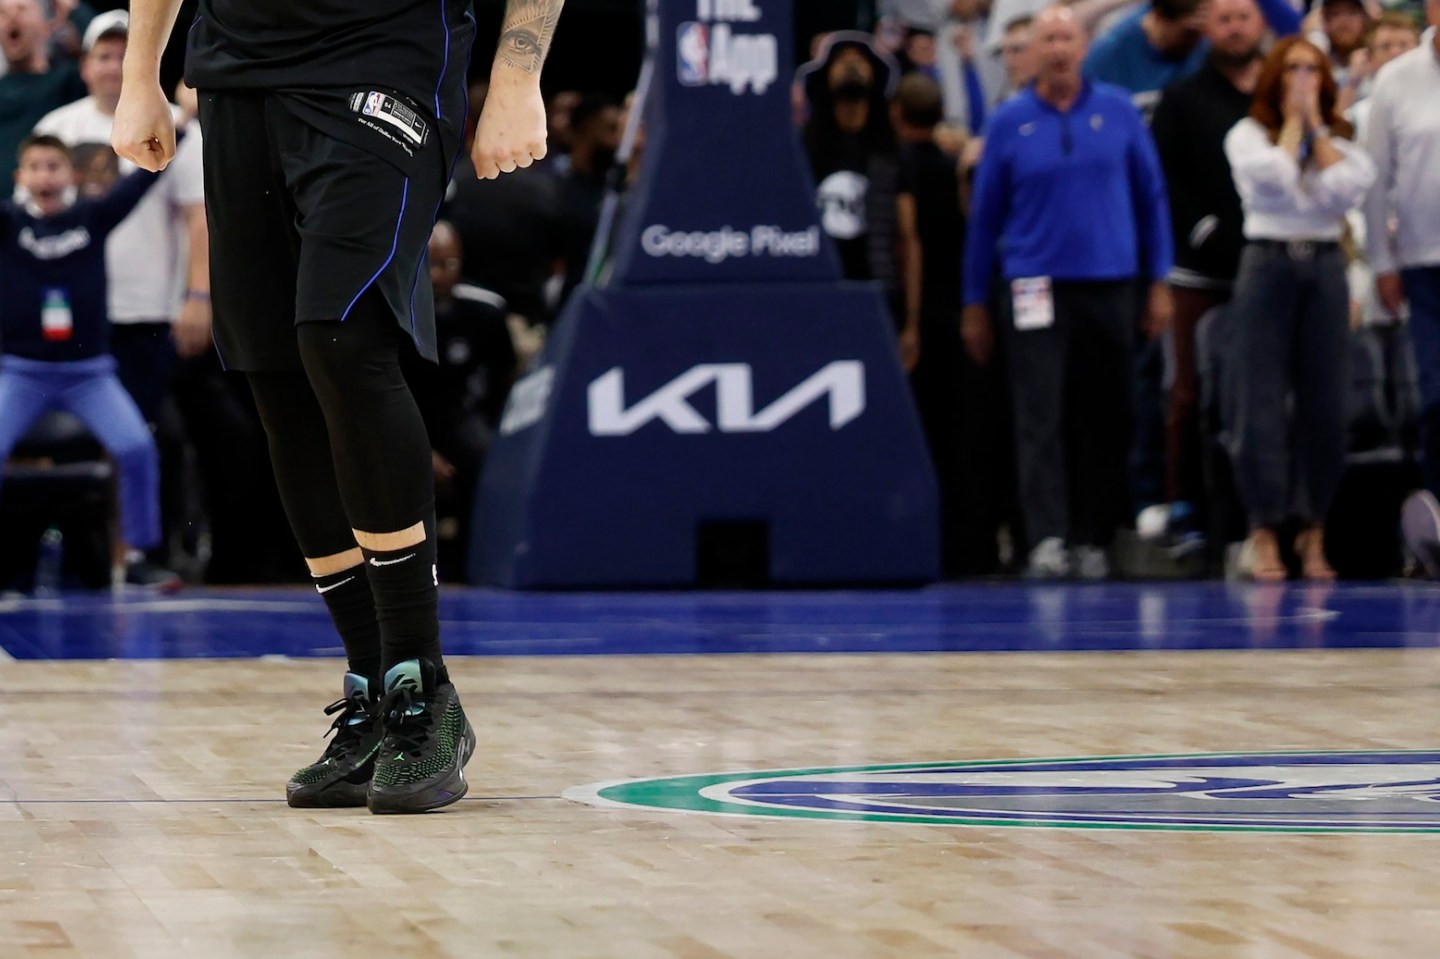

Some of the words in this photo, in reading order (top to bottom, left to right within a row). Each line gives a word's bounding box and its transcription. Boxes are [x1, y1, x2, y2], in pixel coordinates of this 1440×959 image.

[709, 23, 778, 95] App
[641, 224, 750, 263] Google
[751, 224, 820, 258] Pixel
